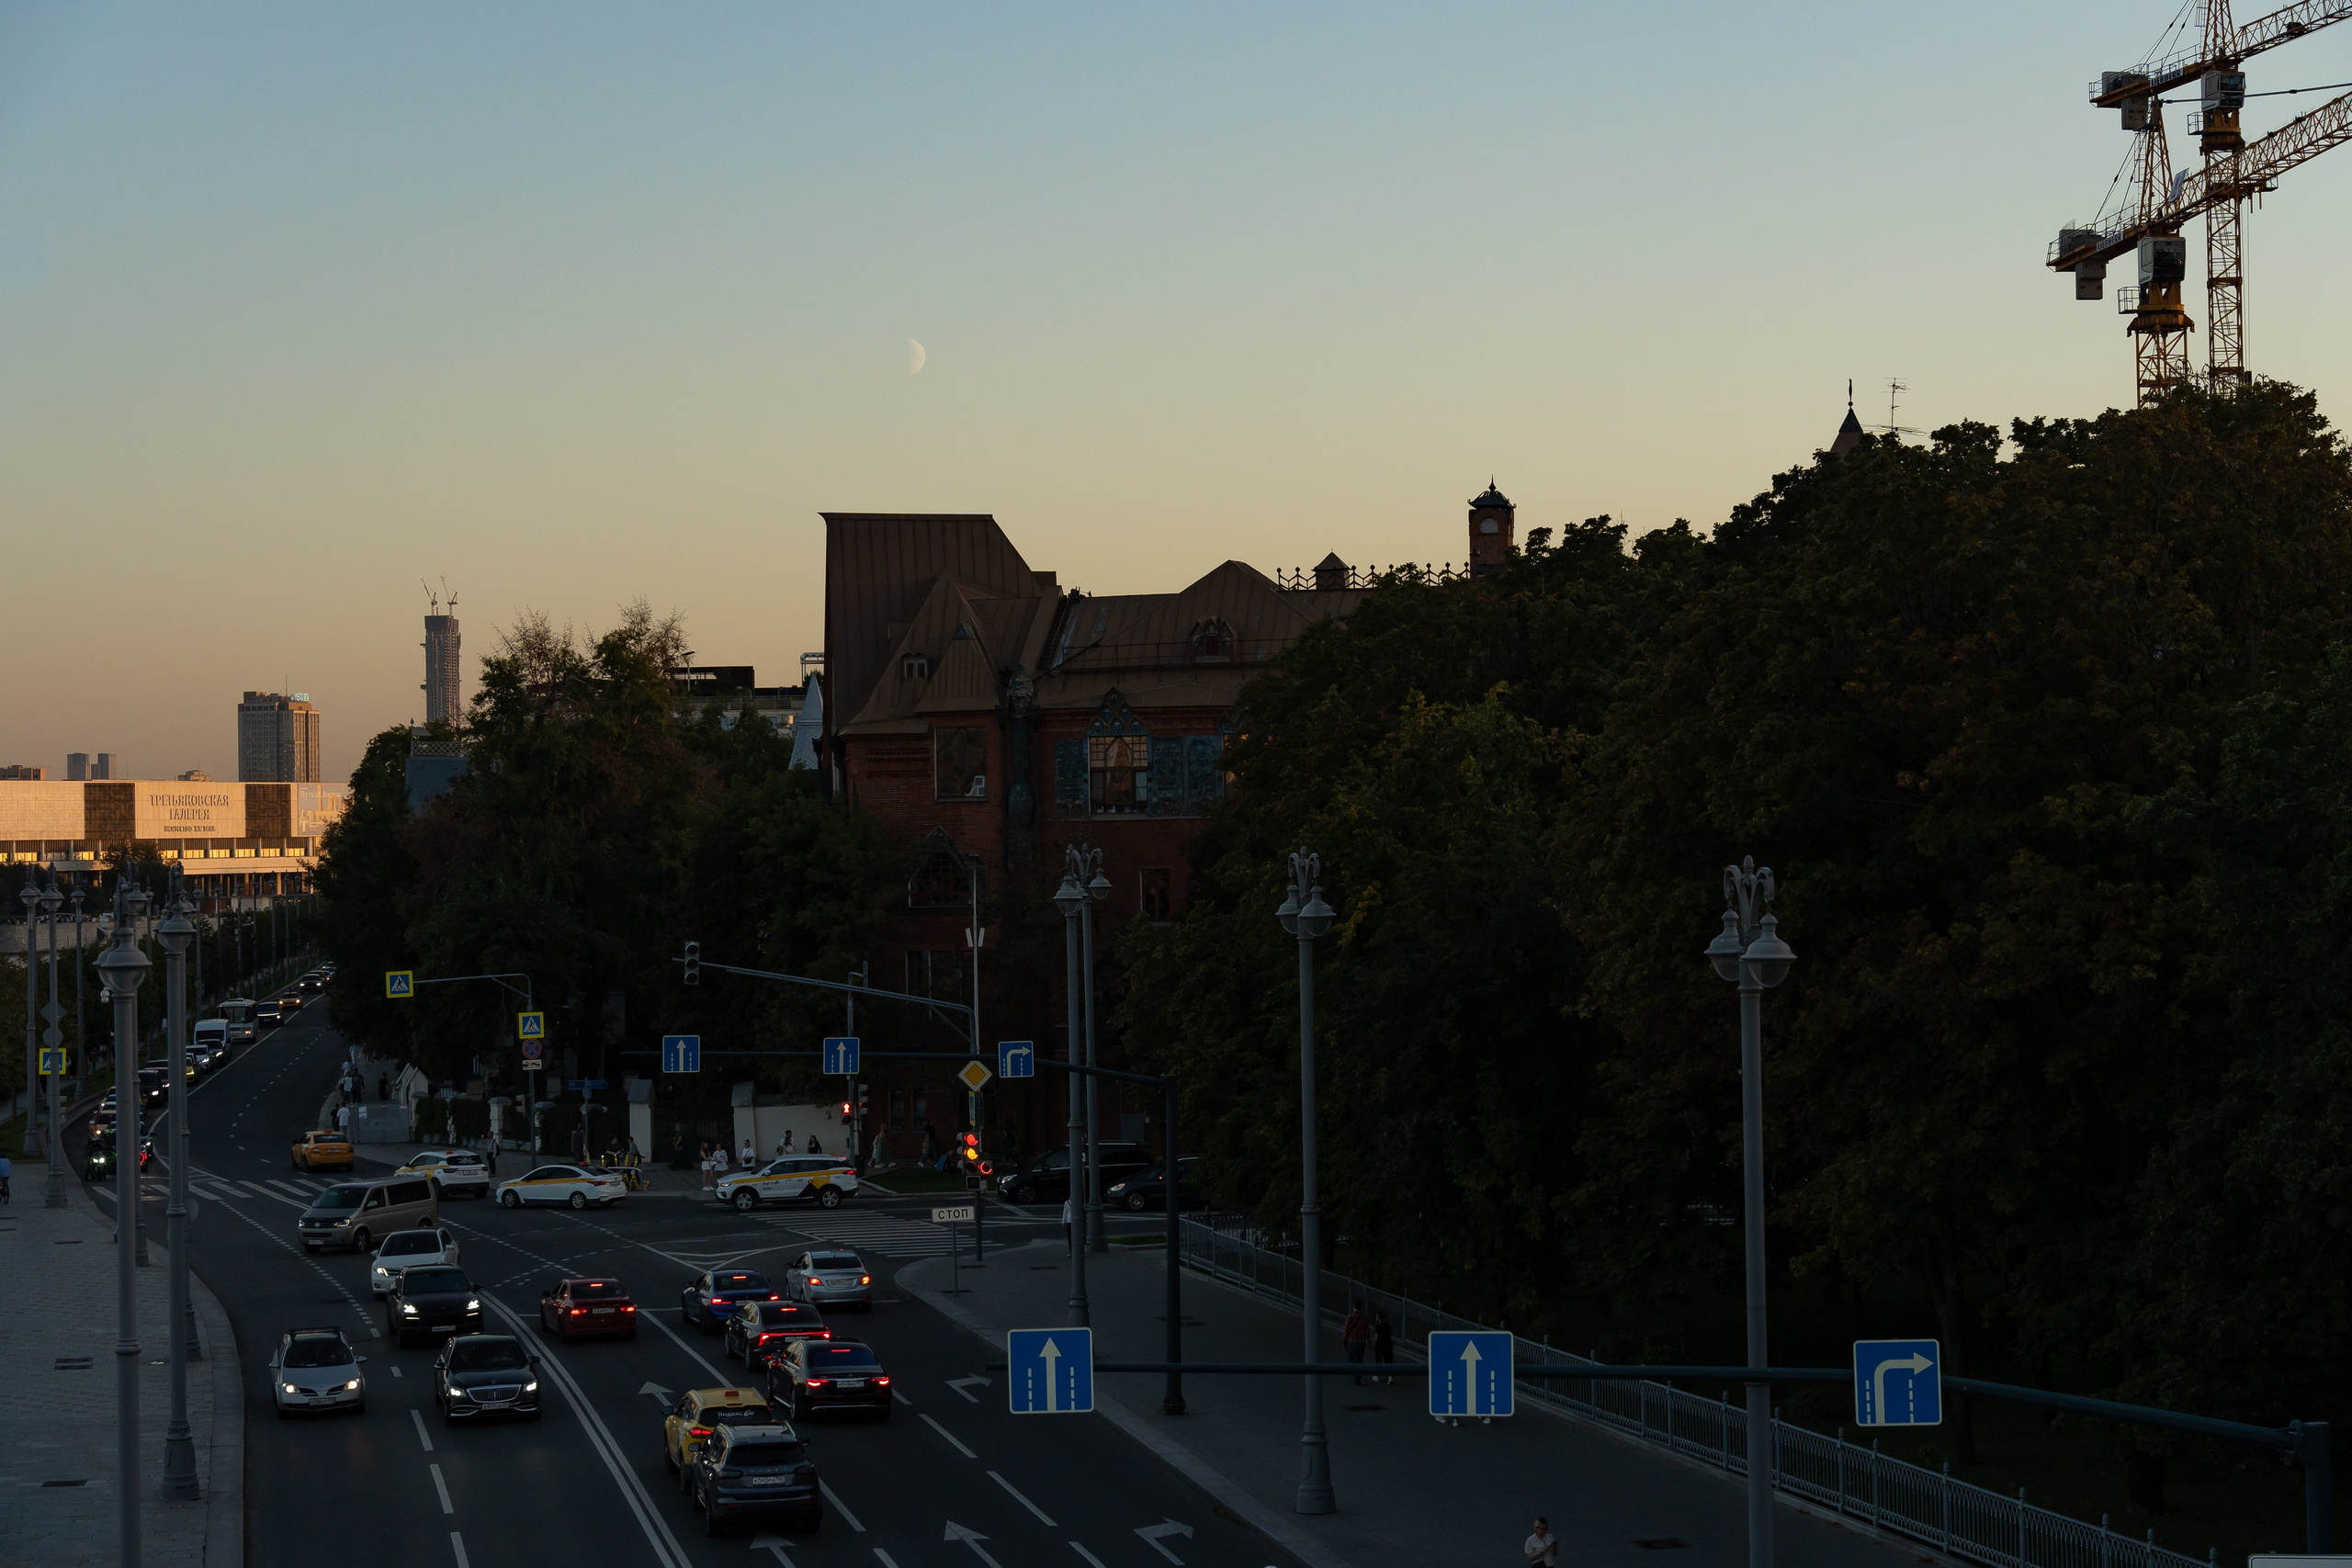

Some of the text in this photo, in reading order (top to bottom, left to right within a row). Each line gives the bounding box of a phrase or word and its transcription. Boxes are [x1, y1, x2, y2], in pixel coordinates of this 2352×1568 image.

[2151, 70, 2181, 86] LIEBHERR
[2098, 232, 2122, 251] LIEBHERR
[150, 795, 228, 807] ТРЕТЬЯКОВСКАЯ
[169, 808, 209, 820] ГАЛЕРЕЯ
[938, 1209, 968, 1220] СТОП
